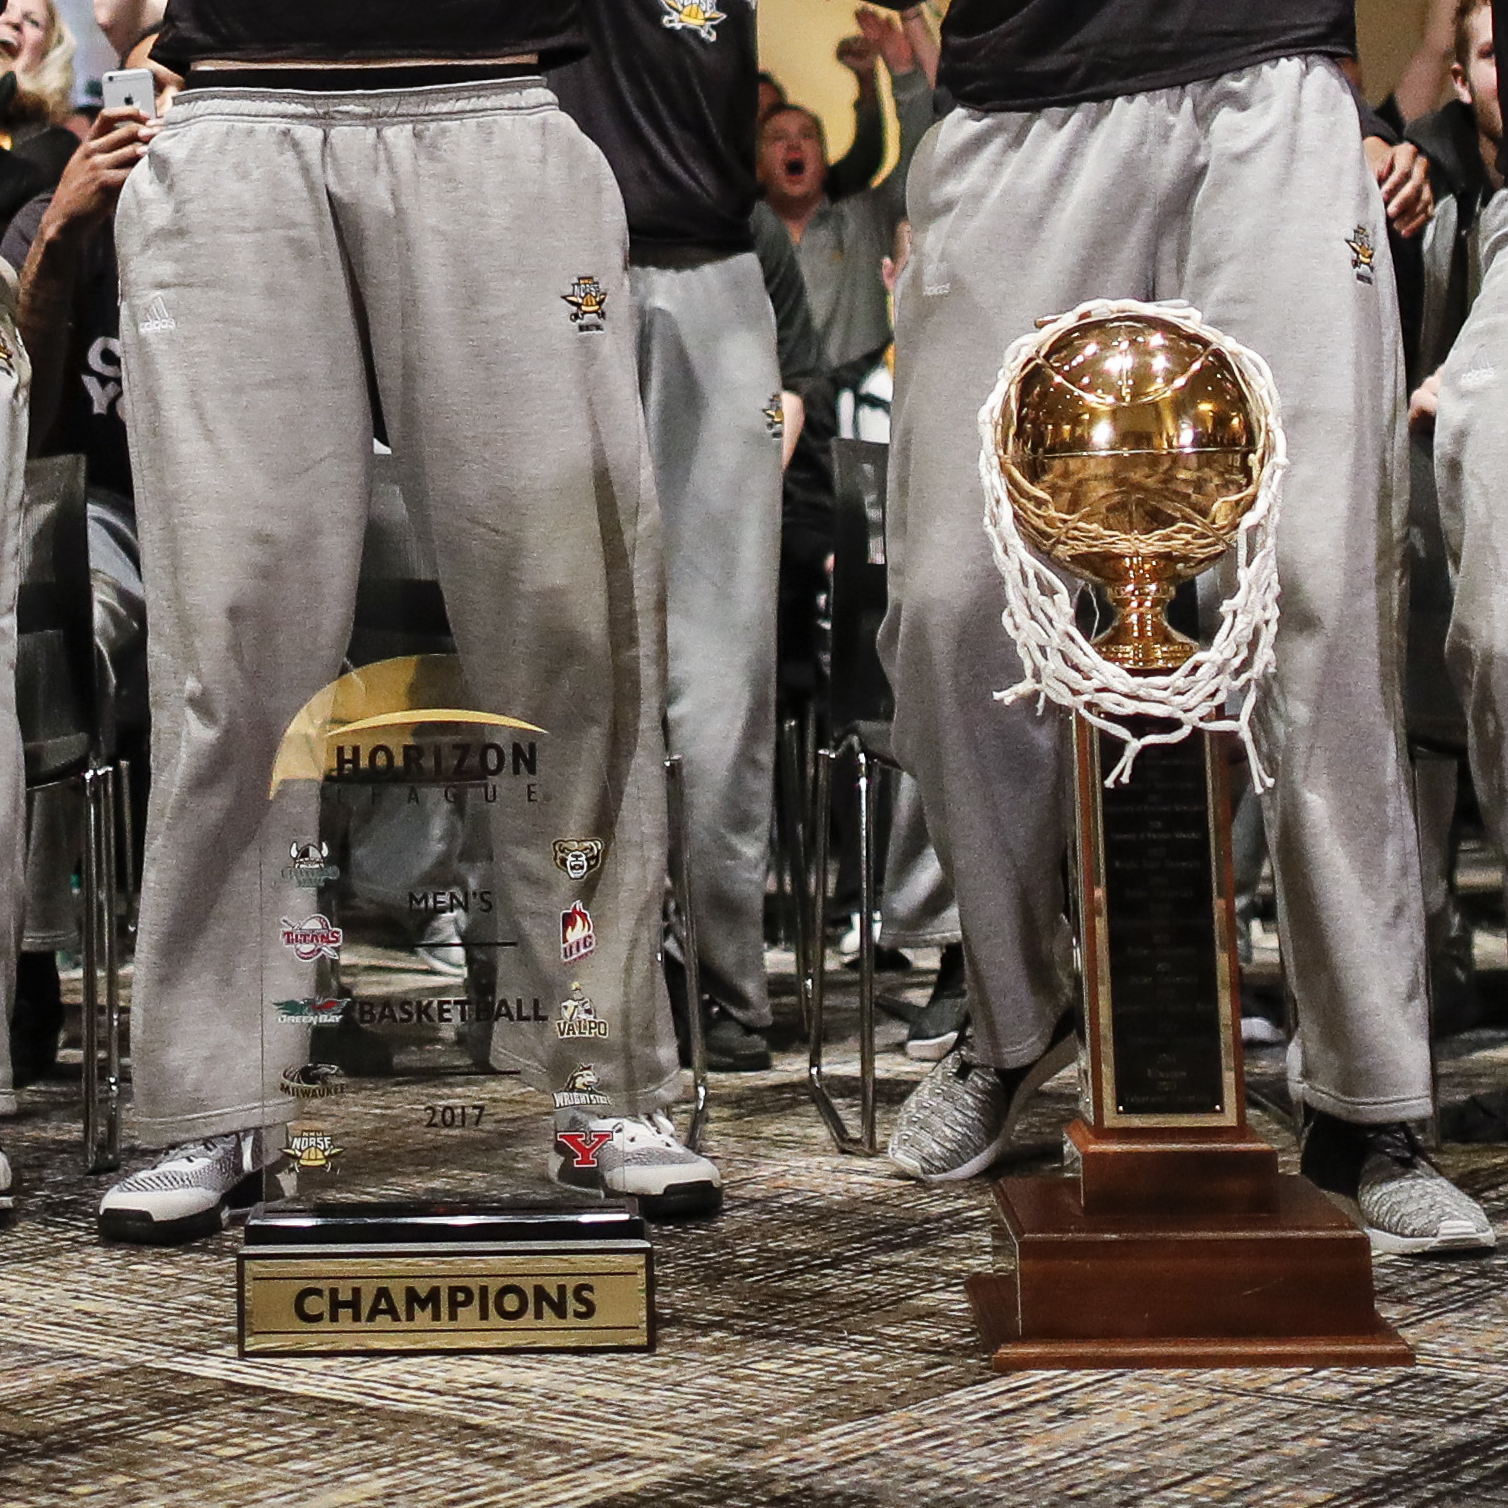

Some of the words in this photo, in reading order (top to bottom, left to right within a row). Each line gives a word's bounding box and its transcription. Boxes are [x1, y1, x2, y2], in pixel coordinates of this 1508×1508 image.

[336, 742, 538, 776] HORIZON
[409, 891, 492, 913] MEN'S
[283, 929, 341, 944] TITANS
[317, 1014, 343, 1024] BAY
[557, 1020, 607, 1037] VALPO
[424, 1105, 486, 1128] 2017
[292, 1136, 332, 1149] NORSE
[293, 1283, 597, 1324] CHAMPIONS
